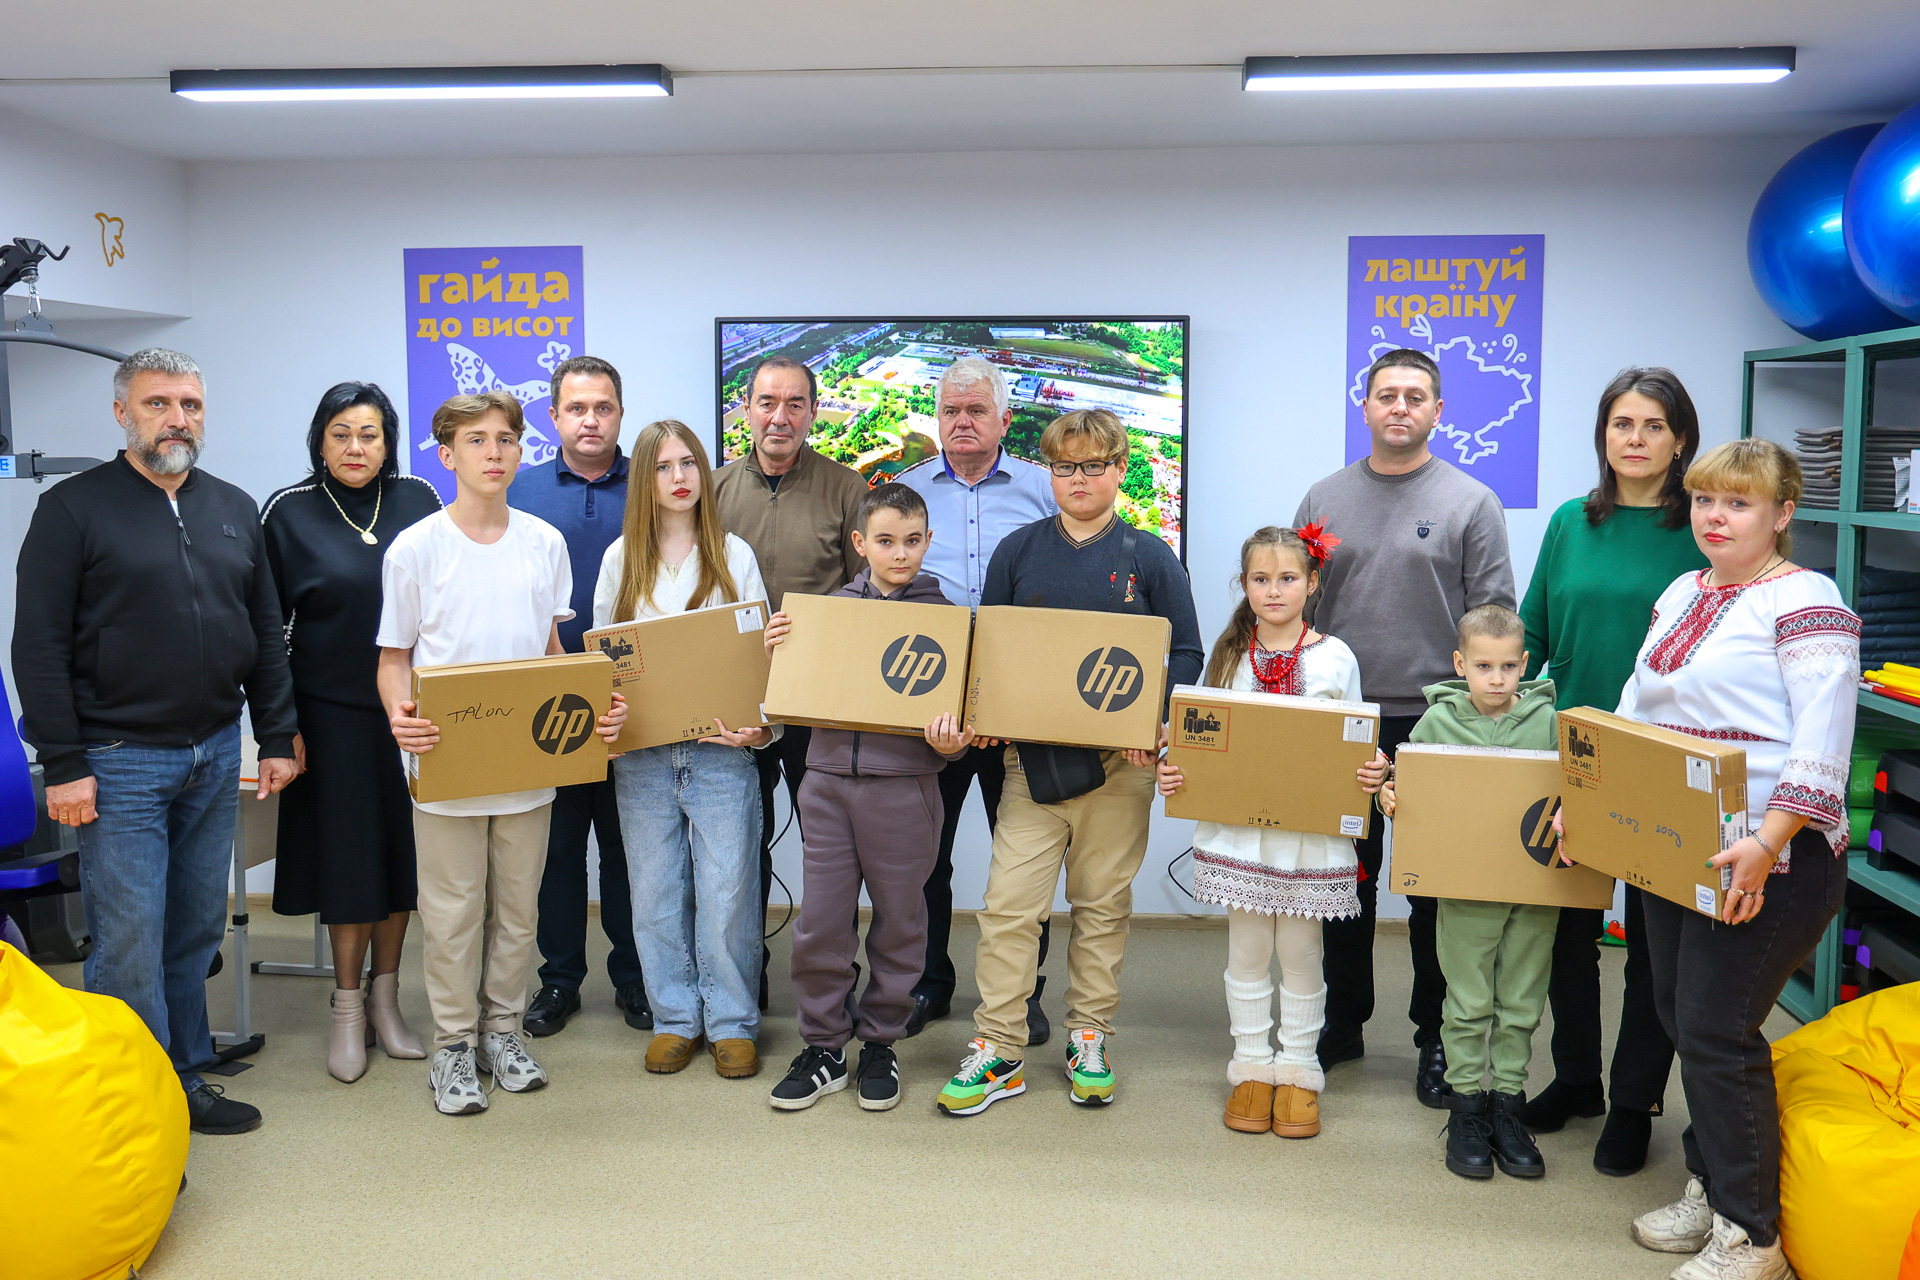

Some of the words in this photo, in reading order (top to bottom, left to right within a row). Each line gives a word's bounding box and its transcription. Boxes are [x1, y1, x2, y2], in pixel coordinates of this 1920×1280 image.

[418, 256, 570, 309] гайда
[1363, 245, 1526, 292] лаштуй
[1375, 282, 1517, 328] країну
[416, 317, 463, 342] до
[472, 316, 575, 337] висот
[615, 661, 631, 669] 3481
[886, 634, 944, 697] hp
[1081, 646, 1140, 713] hp
[447, 702, 514, 724] TALON
[537, 693, 591, 756] hp
[1197, 735, 1215, 743] 3481
[1569, 757, 1579, 766] UN
[1579, 760, 1592, 771] 3481
